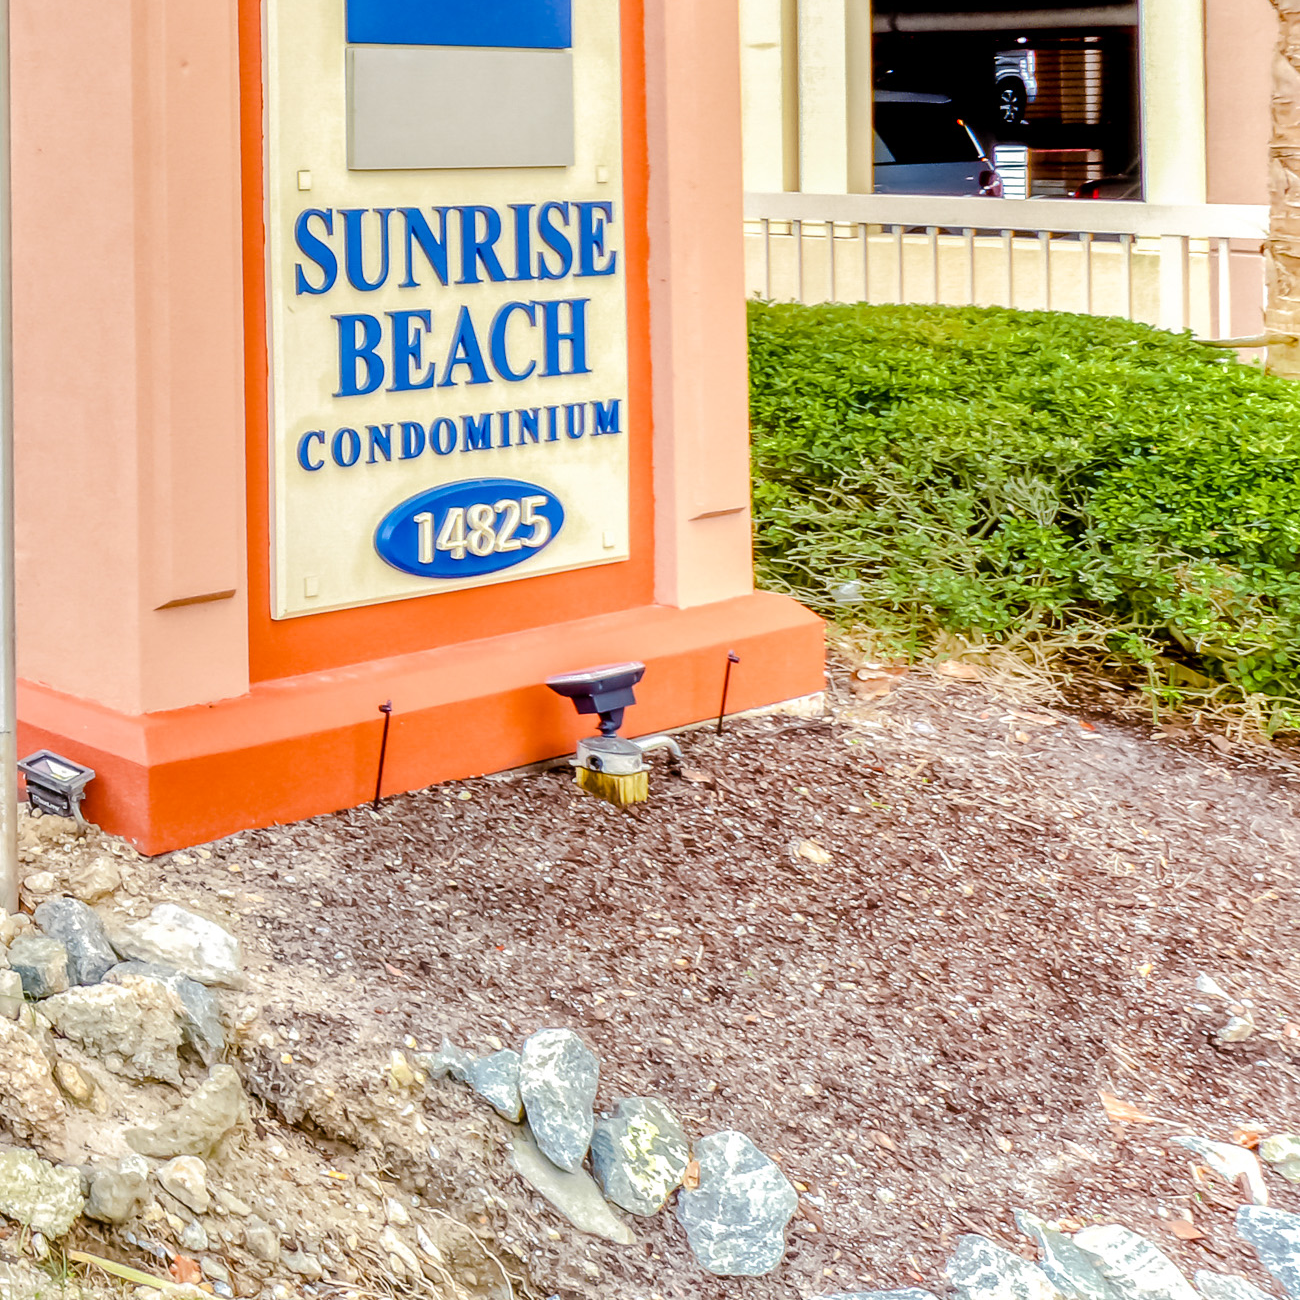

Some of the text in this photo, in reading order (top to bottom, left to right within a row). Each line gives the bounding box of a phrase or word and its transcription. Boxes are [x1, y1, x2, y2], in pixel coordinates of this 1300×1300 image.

[294, 200, 617, 296] SUNRISE
[331, 297, 593, 398] BEACH
[296, 398, 623, 472] CONDOMINIUM
[413, 494, 553, 564] 14825
